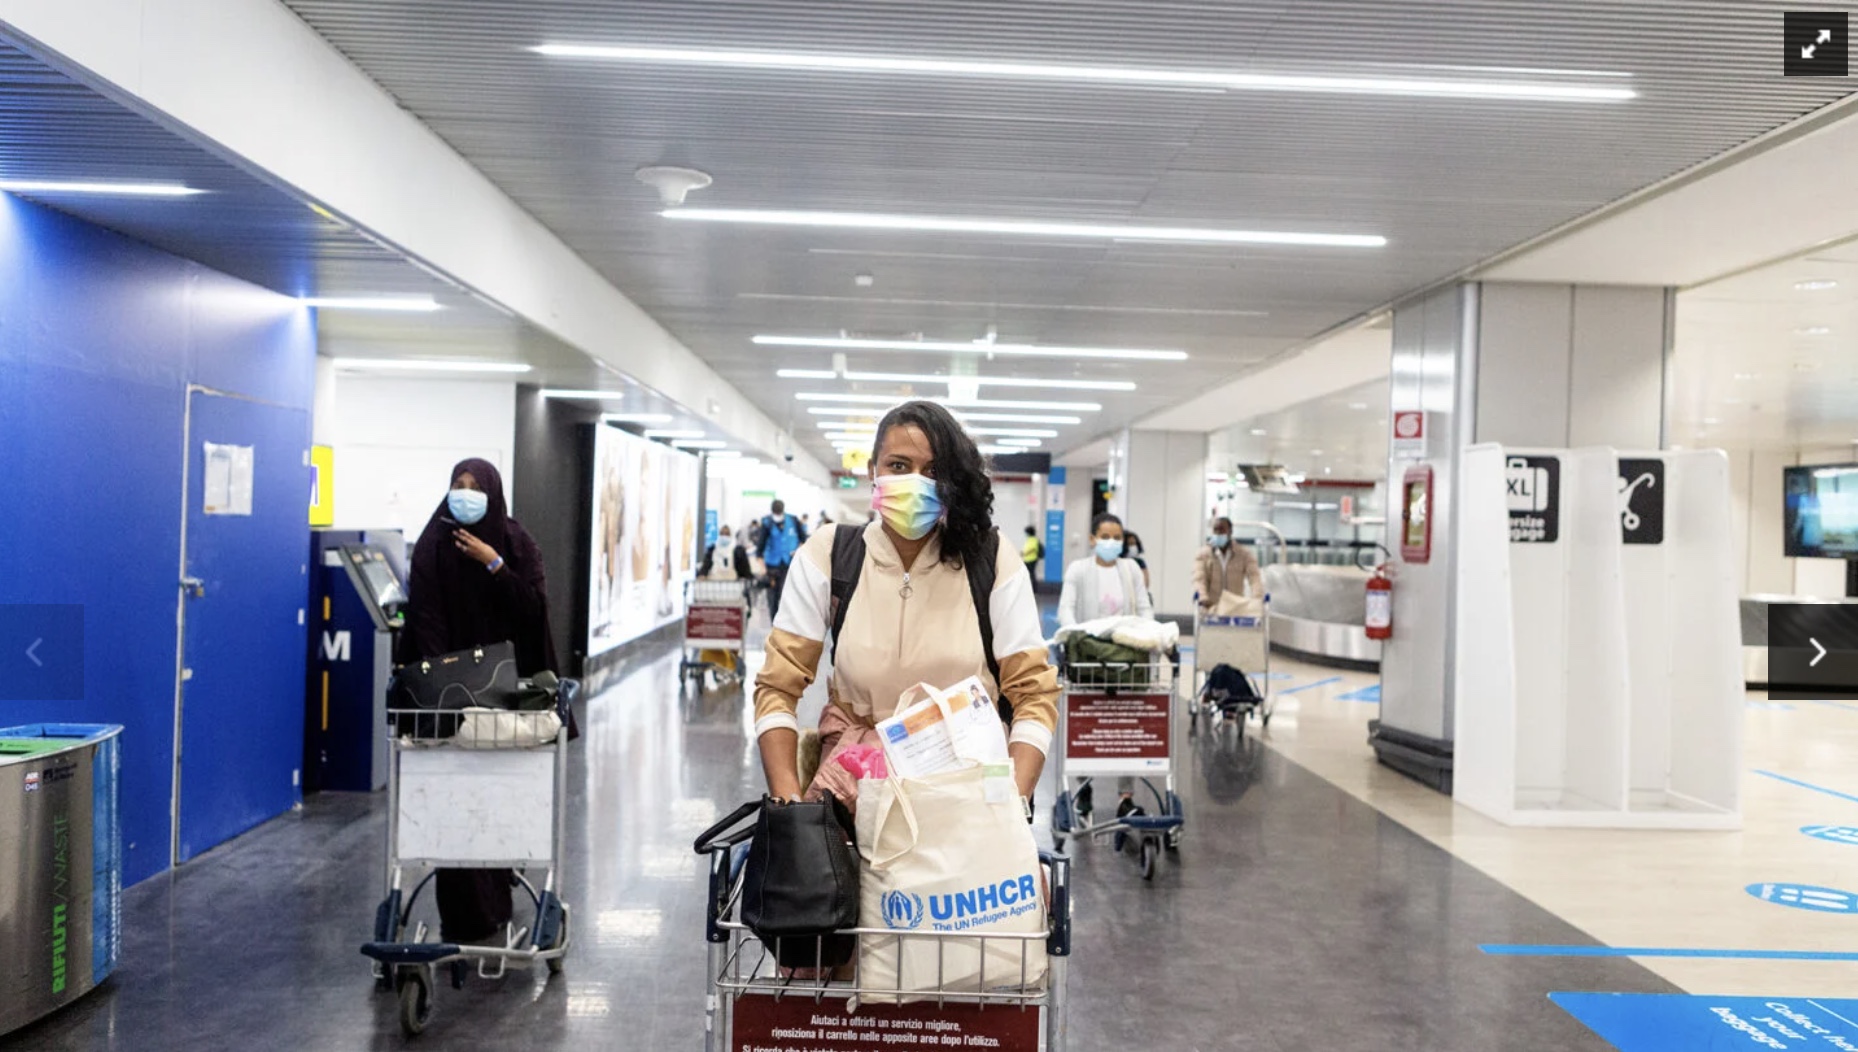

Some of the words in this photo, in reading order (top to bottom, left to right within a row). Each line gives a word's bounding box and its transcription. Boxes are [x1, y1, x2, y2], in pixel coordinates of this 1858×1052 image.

[1506, 478, 1531, 497] XL
[1508, 514, 1546, 528] ersize
[928, 873, 1036, 921] UNHCR
[955, 917, 970, 931] UN
[971, 909, 1007, 927] Refugee
[1009, 901, 1037, 916] Agency
[810, 1014, 839, 1026] Aiutaci
[841, 1018, 848, 1027] a
[877, 1019, 889, 1028] un
[891, 1018, 923, 1029] servizio
[771, 1026, 816, 1039] riposiziona
[818, 1028, 824, 1039] il
[826, 1030, 858, 1041] carrello
[860, 1031, 880, 1042] nelle
[882, 1032, 917, 1044] apposite
[920, 1034, 939, 1045] aree
[941, 1033, 962, 1047] dopo
